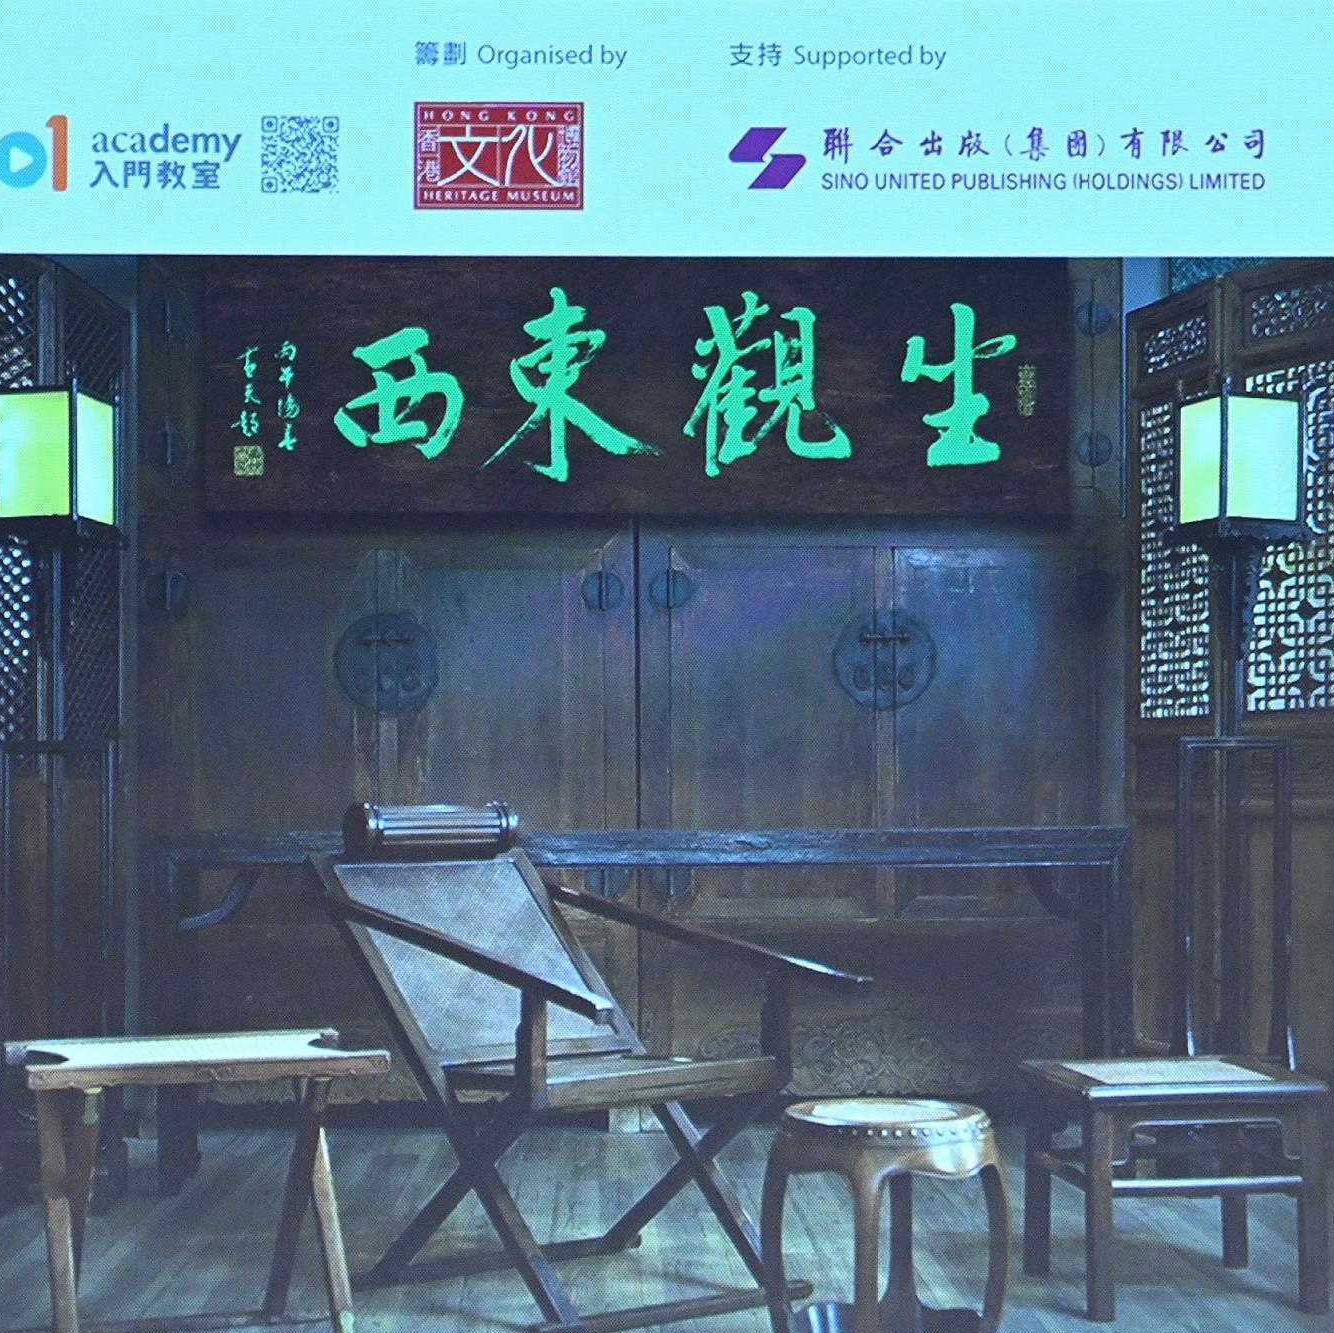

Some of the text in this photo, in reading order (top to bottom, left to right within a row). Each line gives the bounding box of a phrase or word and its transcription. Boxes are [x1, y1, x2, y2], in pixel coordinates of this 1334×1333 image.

[478, 44, 592, 70] Organised
[601, 44, 627, 69] by
[730, 42, 946, 70] 支持 Supported by
[423, 110, 576, 121] HONG KONG
[92, 123, 242, 161] academy
[437, 124, 564, 187] 文化
[90, 161, 221, 190] 入門教室
[822, 172, 1265, 190] SINO UNITED PUBLISHING (HOLDINGS) LIMITED
[423, 191, 575, 201] HERITAGE MUSEUM
